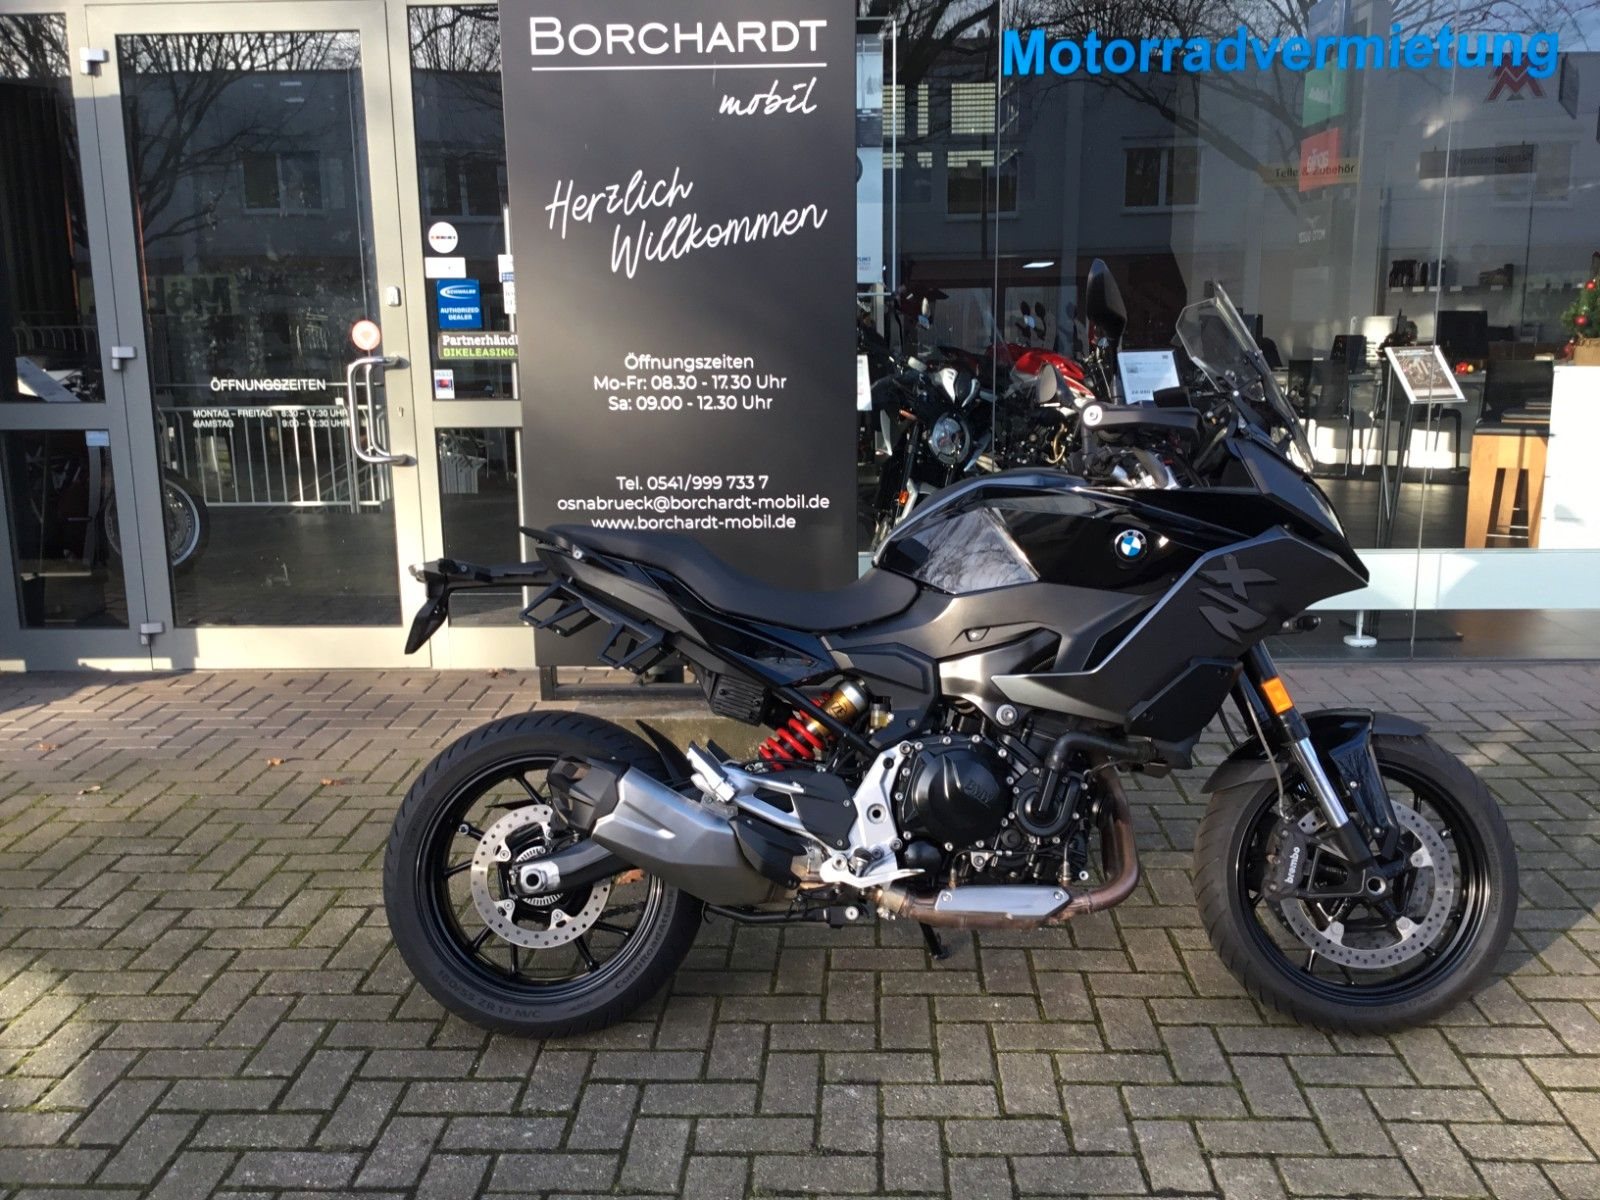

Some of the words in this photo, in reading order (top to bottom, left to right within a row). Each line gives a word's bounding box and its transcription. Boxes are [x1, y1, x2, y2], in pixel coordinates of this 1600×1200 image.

[529, 16, 828, 56] BORCHARDT
[1002, 25, 1560, 79] Motorradvermietung
[718, 76, 818, 116] mobil
[544, 166, 694, 240] Herzlich
[610, 203, 829, 279] Willkommen
[440, 306, 480, 314] AUTHORIZED
[448, 313, 473, 321] DEALER
[624, 352, 754, 373] Öffnungszeiten
[209, 376, 327, 392] ÖFFNUNGSZEITEN
[593, 375, 647, 391] Mo-Fr:
[650, 374, 698, 390] 08.30
[711, 374, 752, 390] 17.30
[756, 373, 787, 389] Uhr
[608, 396, 632, 411] Sa:
[635, 395, 683, 411] 09.00
[697, 395, 738, 410] 12.30
[742, 394, 773, 410] Uhr
[192, 408, 230, 419] MONTAG
[237, 408, 273, 418] FREITAG
[329, 408, 348, 418] UHR
[192, 419, 235, 428] SAMSTAG
[616, 475, 644, 491] Tel.
[646, 474, 723, 492] 0541/999
[726, 475, 756, 490] 733
[758, 475, 769, 490] 7
[557, 494, 831, 513] osnabrueck@borchardt-mobil.de
[591, 514, 797, 531] www.borchardt-mobil.de
[1284, 846, 1301, 885] brembo
